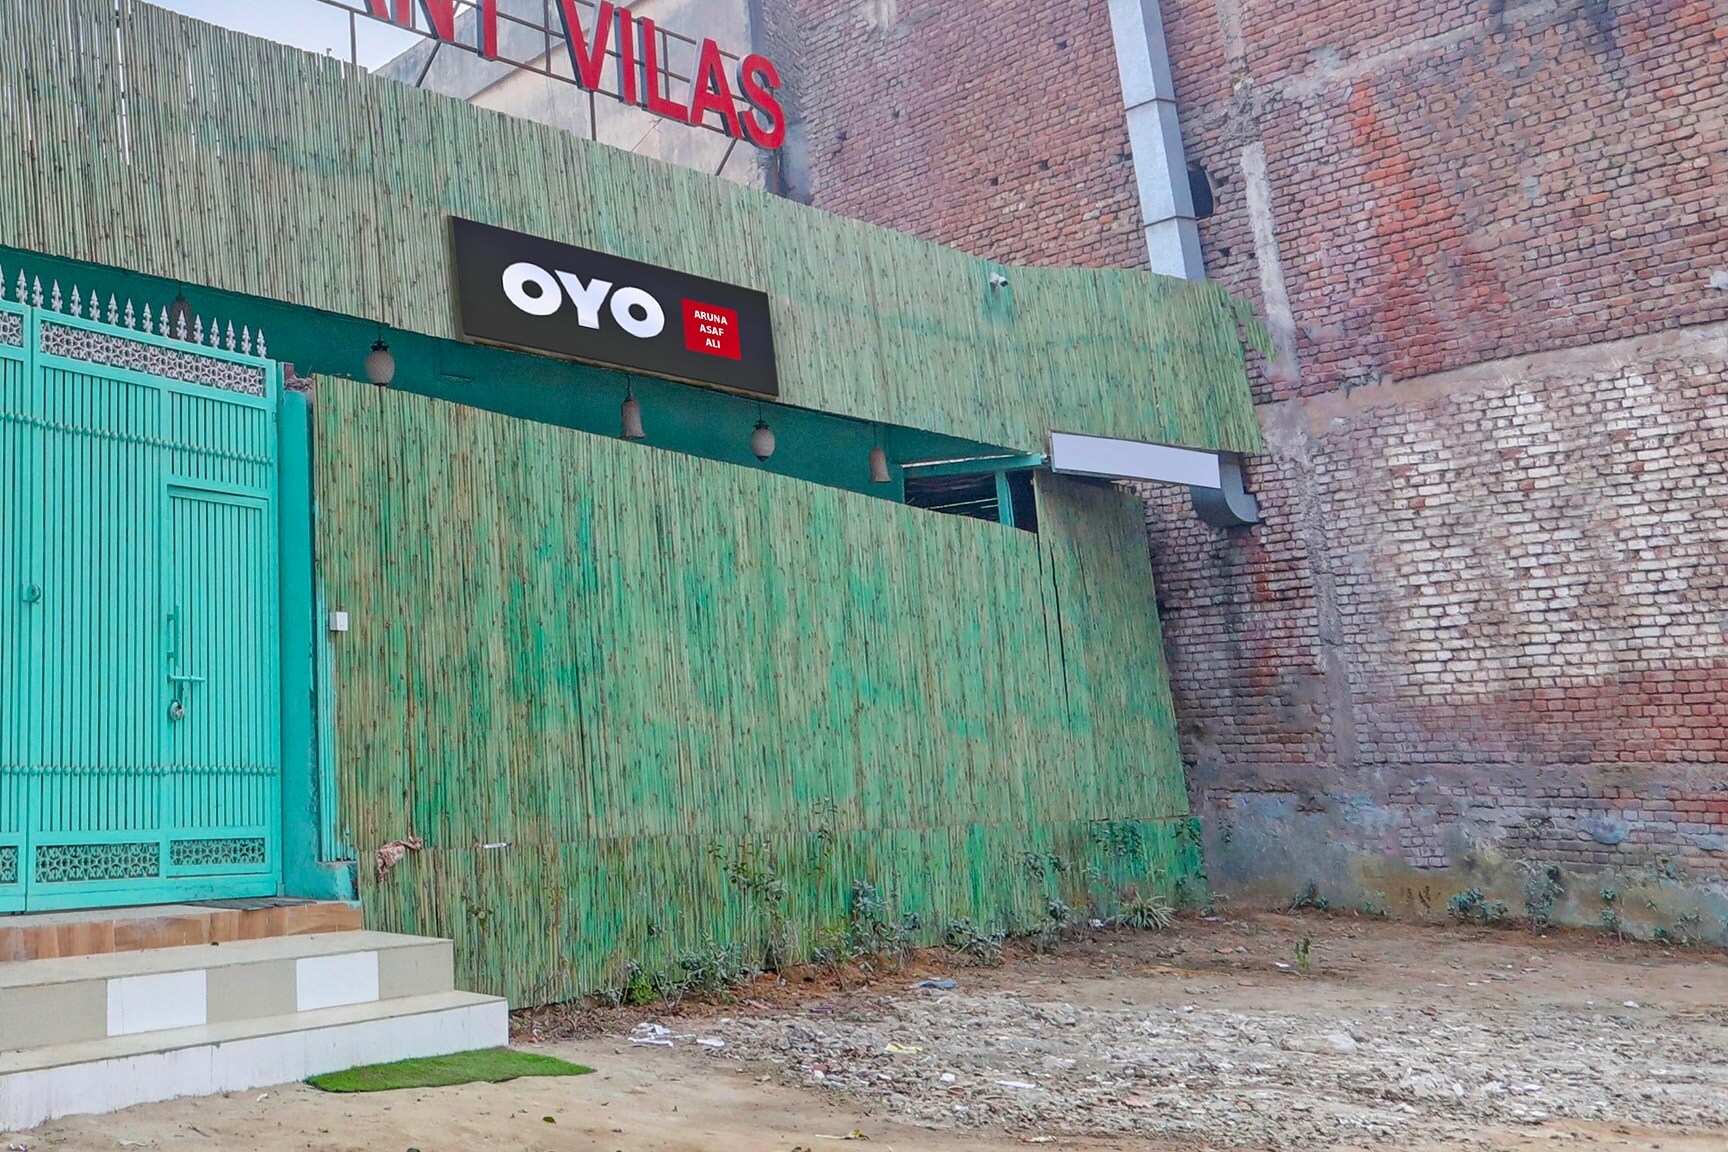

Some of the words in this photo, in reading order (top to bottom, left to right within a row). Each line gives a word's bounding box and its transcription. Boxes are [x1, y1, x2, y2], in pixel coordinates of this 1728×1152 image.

[502, 261, 665, 338] OYO
[694, 309, 728, 325] ARUNA
[699, 323, 724, 337] ASAF
[705, 337, 721, 349] ALI
